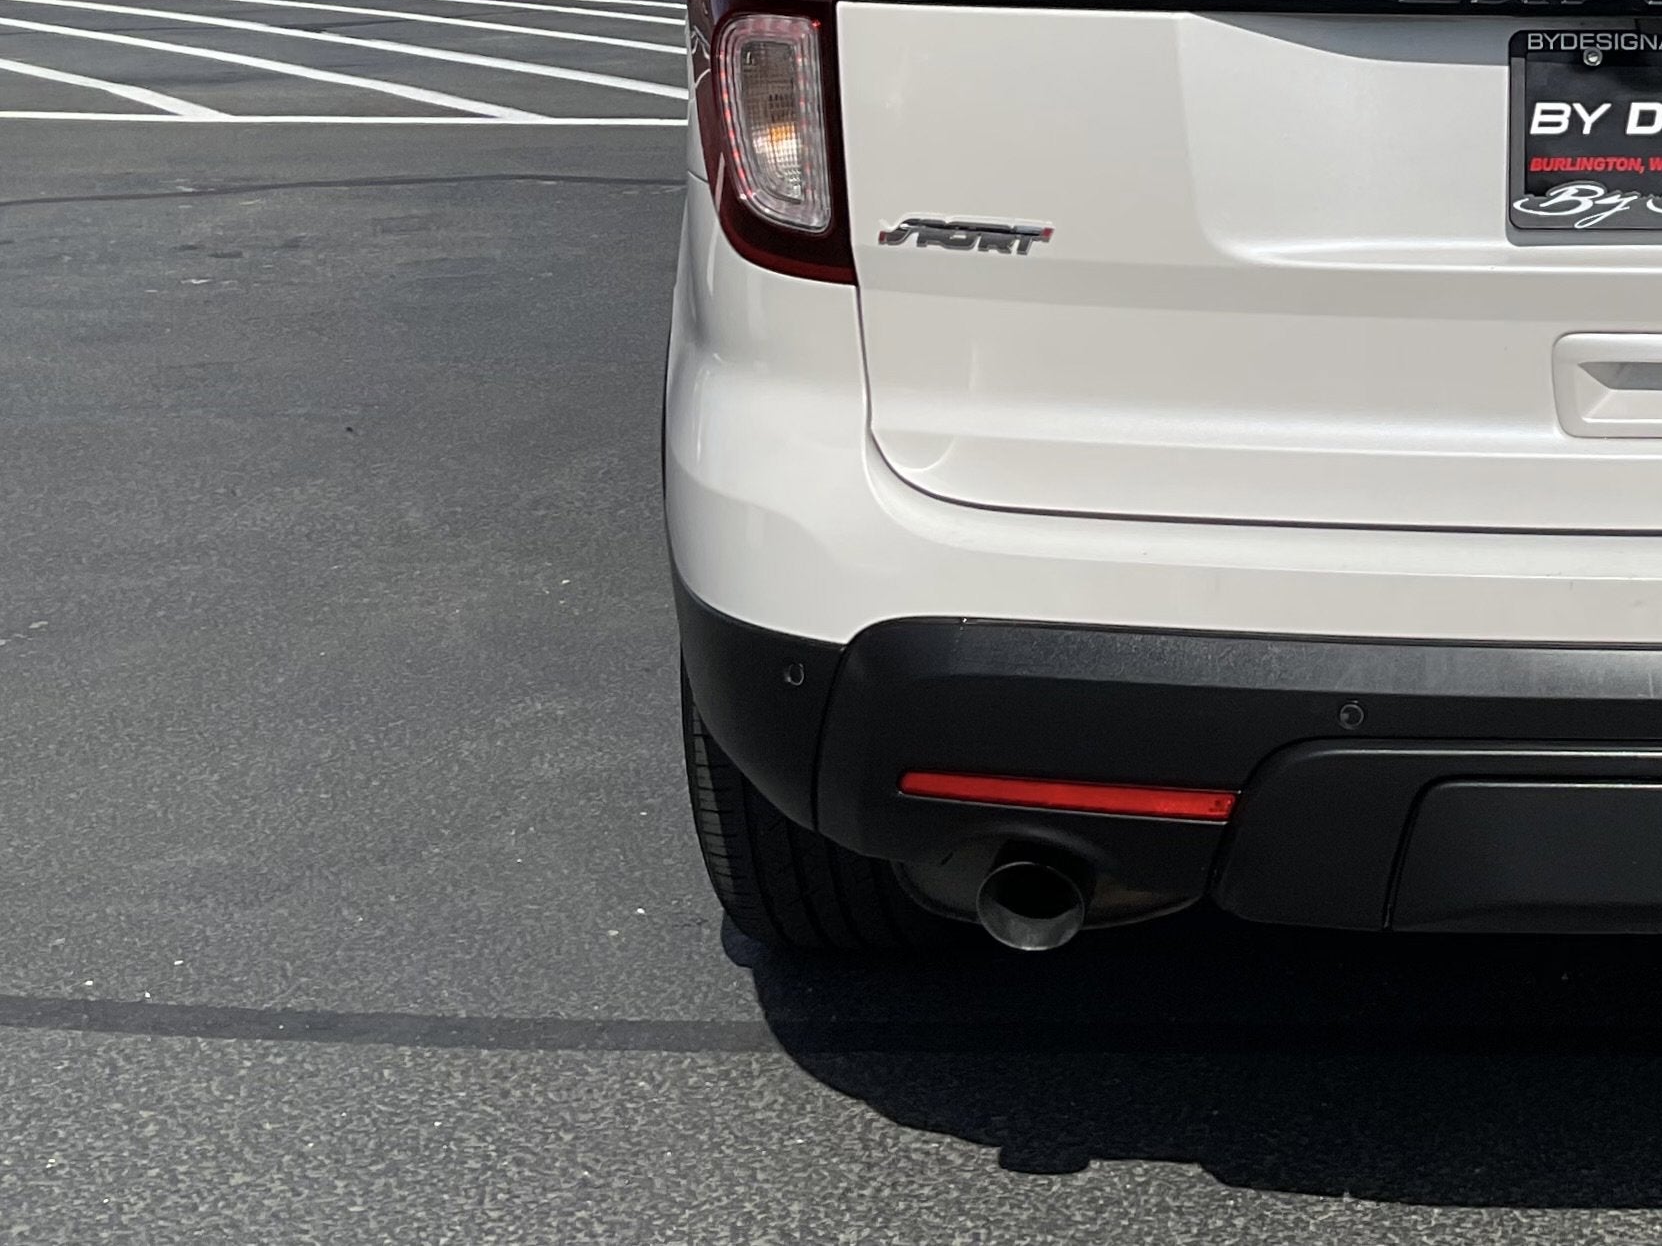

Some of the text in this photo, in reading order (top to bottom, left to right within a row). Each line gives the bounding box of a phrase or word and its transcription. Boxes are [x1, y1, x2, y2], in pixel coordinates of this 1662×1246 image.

[1530, 101, 1611, 135] BY
[1530, 157, 1644, 173] BURLINGTON,
[1513, 184, 1638, 229] By
[878, 218, 1055, 256] SPORT
